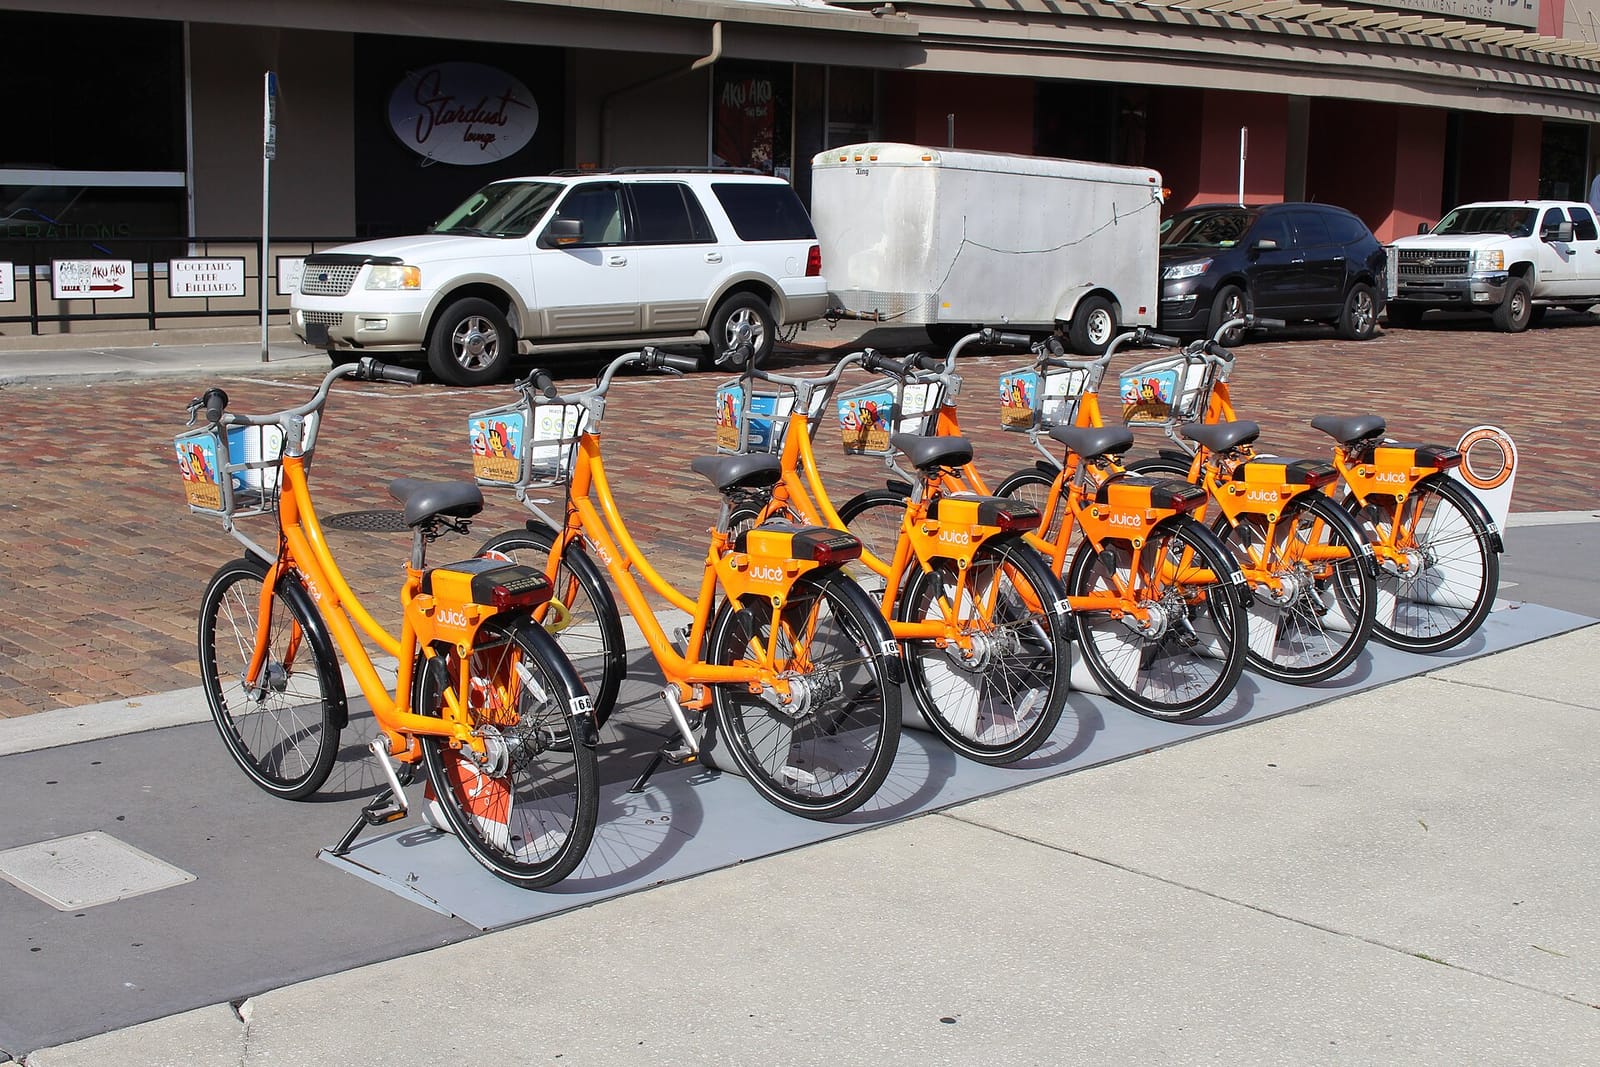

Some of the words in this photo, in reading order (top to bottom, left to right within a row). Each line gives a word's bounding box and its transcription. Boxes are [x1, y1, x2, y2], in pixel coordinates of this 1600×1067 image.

[1462, 4, 1493, 17] HOMES
[722, 81, 746, 108] AKU
[415, 69, 531, 144] Stardust
[855, 168, 869, 176] Xing
[92, 266, 108, 278] AKU
[110, 263, 126, 275] AKU
